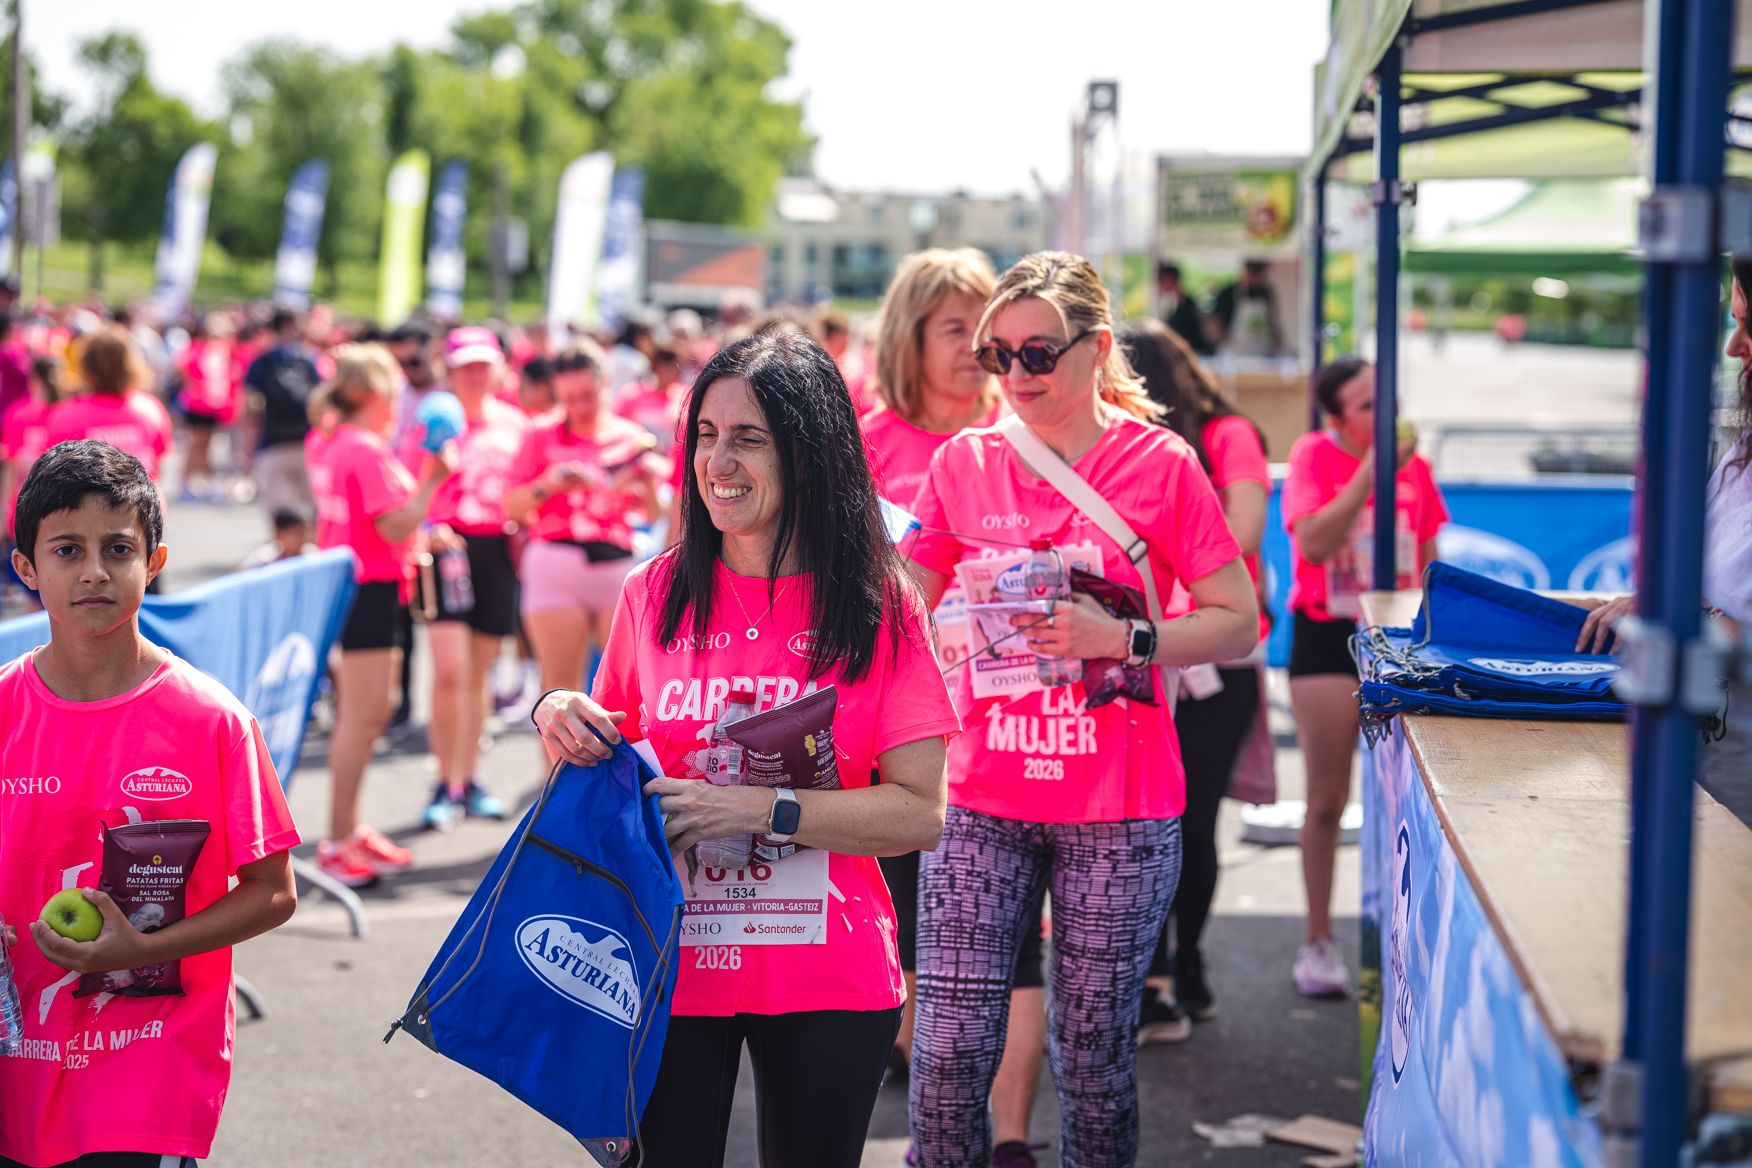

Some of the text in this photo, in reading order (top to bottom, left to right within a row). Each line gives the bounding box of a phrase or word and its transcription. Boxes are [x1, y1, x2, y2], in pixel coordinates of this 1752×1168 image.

[992, 672, 1038, 687] OYSHO
[1042, 684, 1075, 715] LA
[987, 712, 1098, 755] MUJER
[1024, 758, 1064, 780] 2026
[126, 777, 187, 793] ASTURIANA
[128, 863, 183, 876] degusteat
[724, 887, 757, 899] 1534
[691, 903, 702, 913] DE
[704, 903, 715, 912] LA
[717, 903, 746, 912] MUJER
[752, 902, 819, 911] VITORIA-GASTEIZ
[680, 922, 722, 935] YSHO
[758, 924, 807, 934] Santander
[559, 934, 604, 965] CENTRAL
[694, 945, 742, 970] 2026
[525, 927, 636, 1021] ASTURIANA
[84, 1031, 105, 1051] LA
